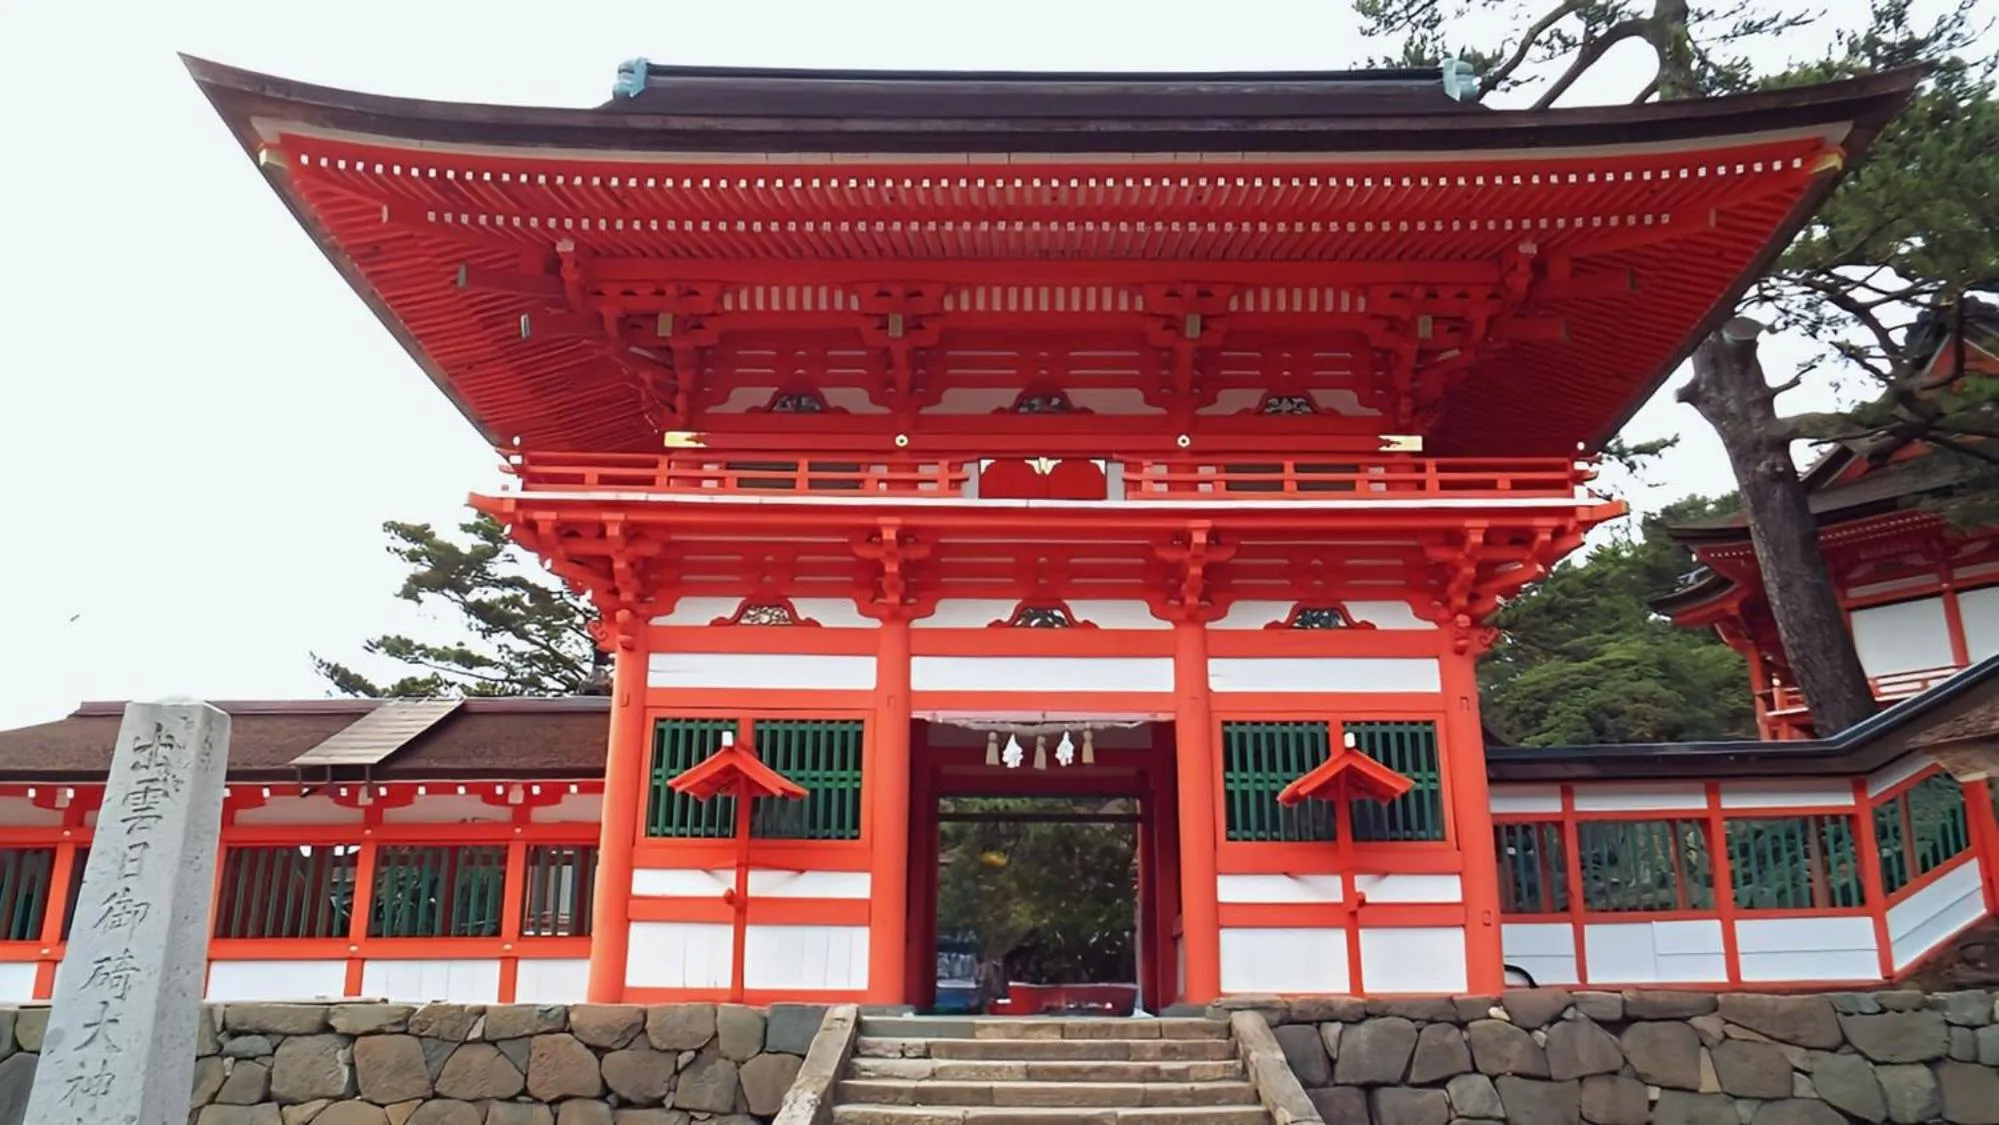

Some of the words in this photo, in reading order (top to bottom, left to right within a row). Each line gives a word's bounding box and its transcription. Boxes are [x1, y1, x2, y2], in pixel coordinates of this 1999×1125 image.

[57, 721, 173, 1125] 出雲日御碕大神
